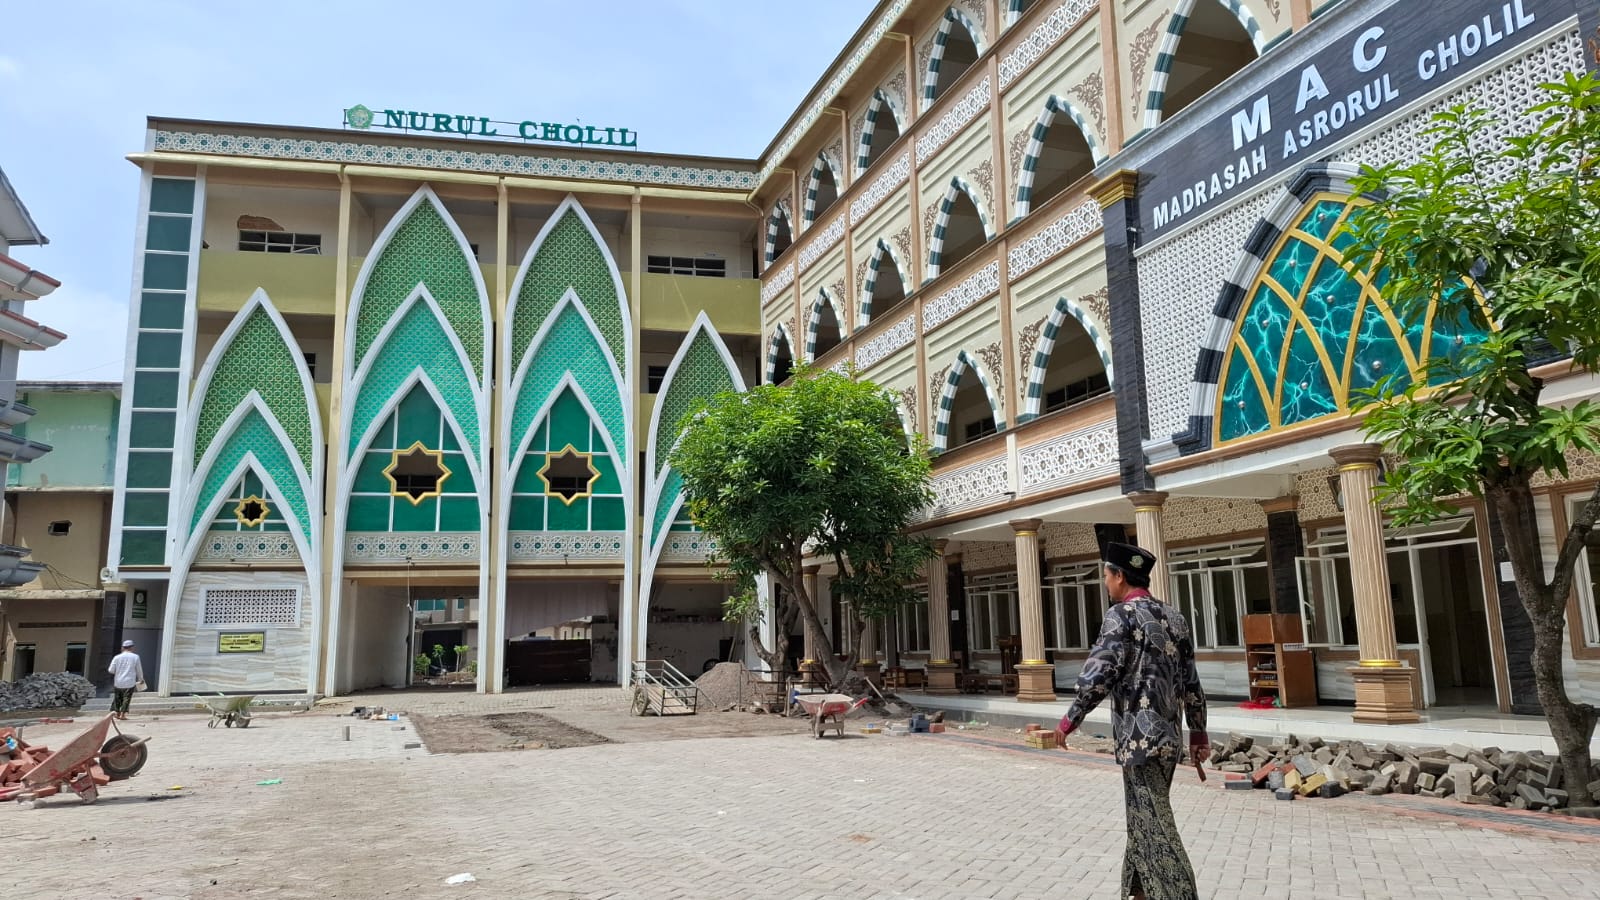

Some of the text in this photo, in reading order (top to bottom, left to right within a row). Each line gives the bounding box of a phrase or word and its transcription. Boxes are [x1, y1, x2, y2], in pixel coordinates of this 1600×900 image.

[384, 109, 637, 147] NURUL CHOLIL
[1153, 0, 1536, 230] MADRASAH ASRORUL CHOLIL
